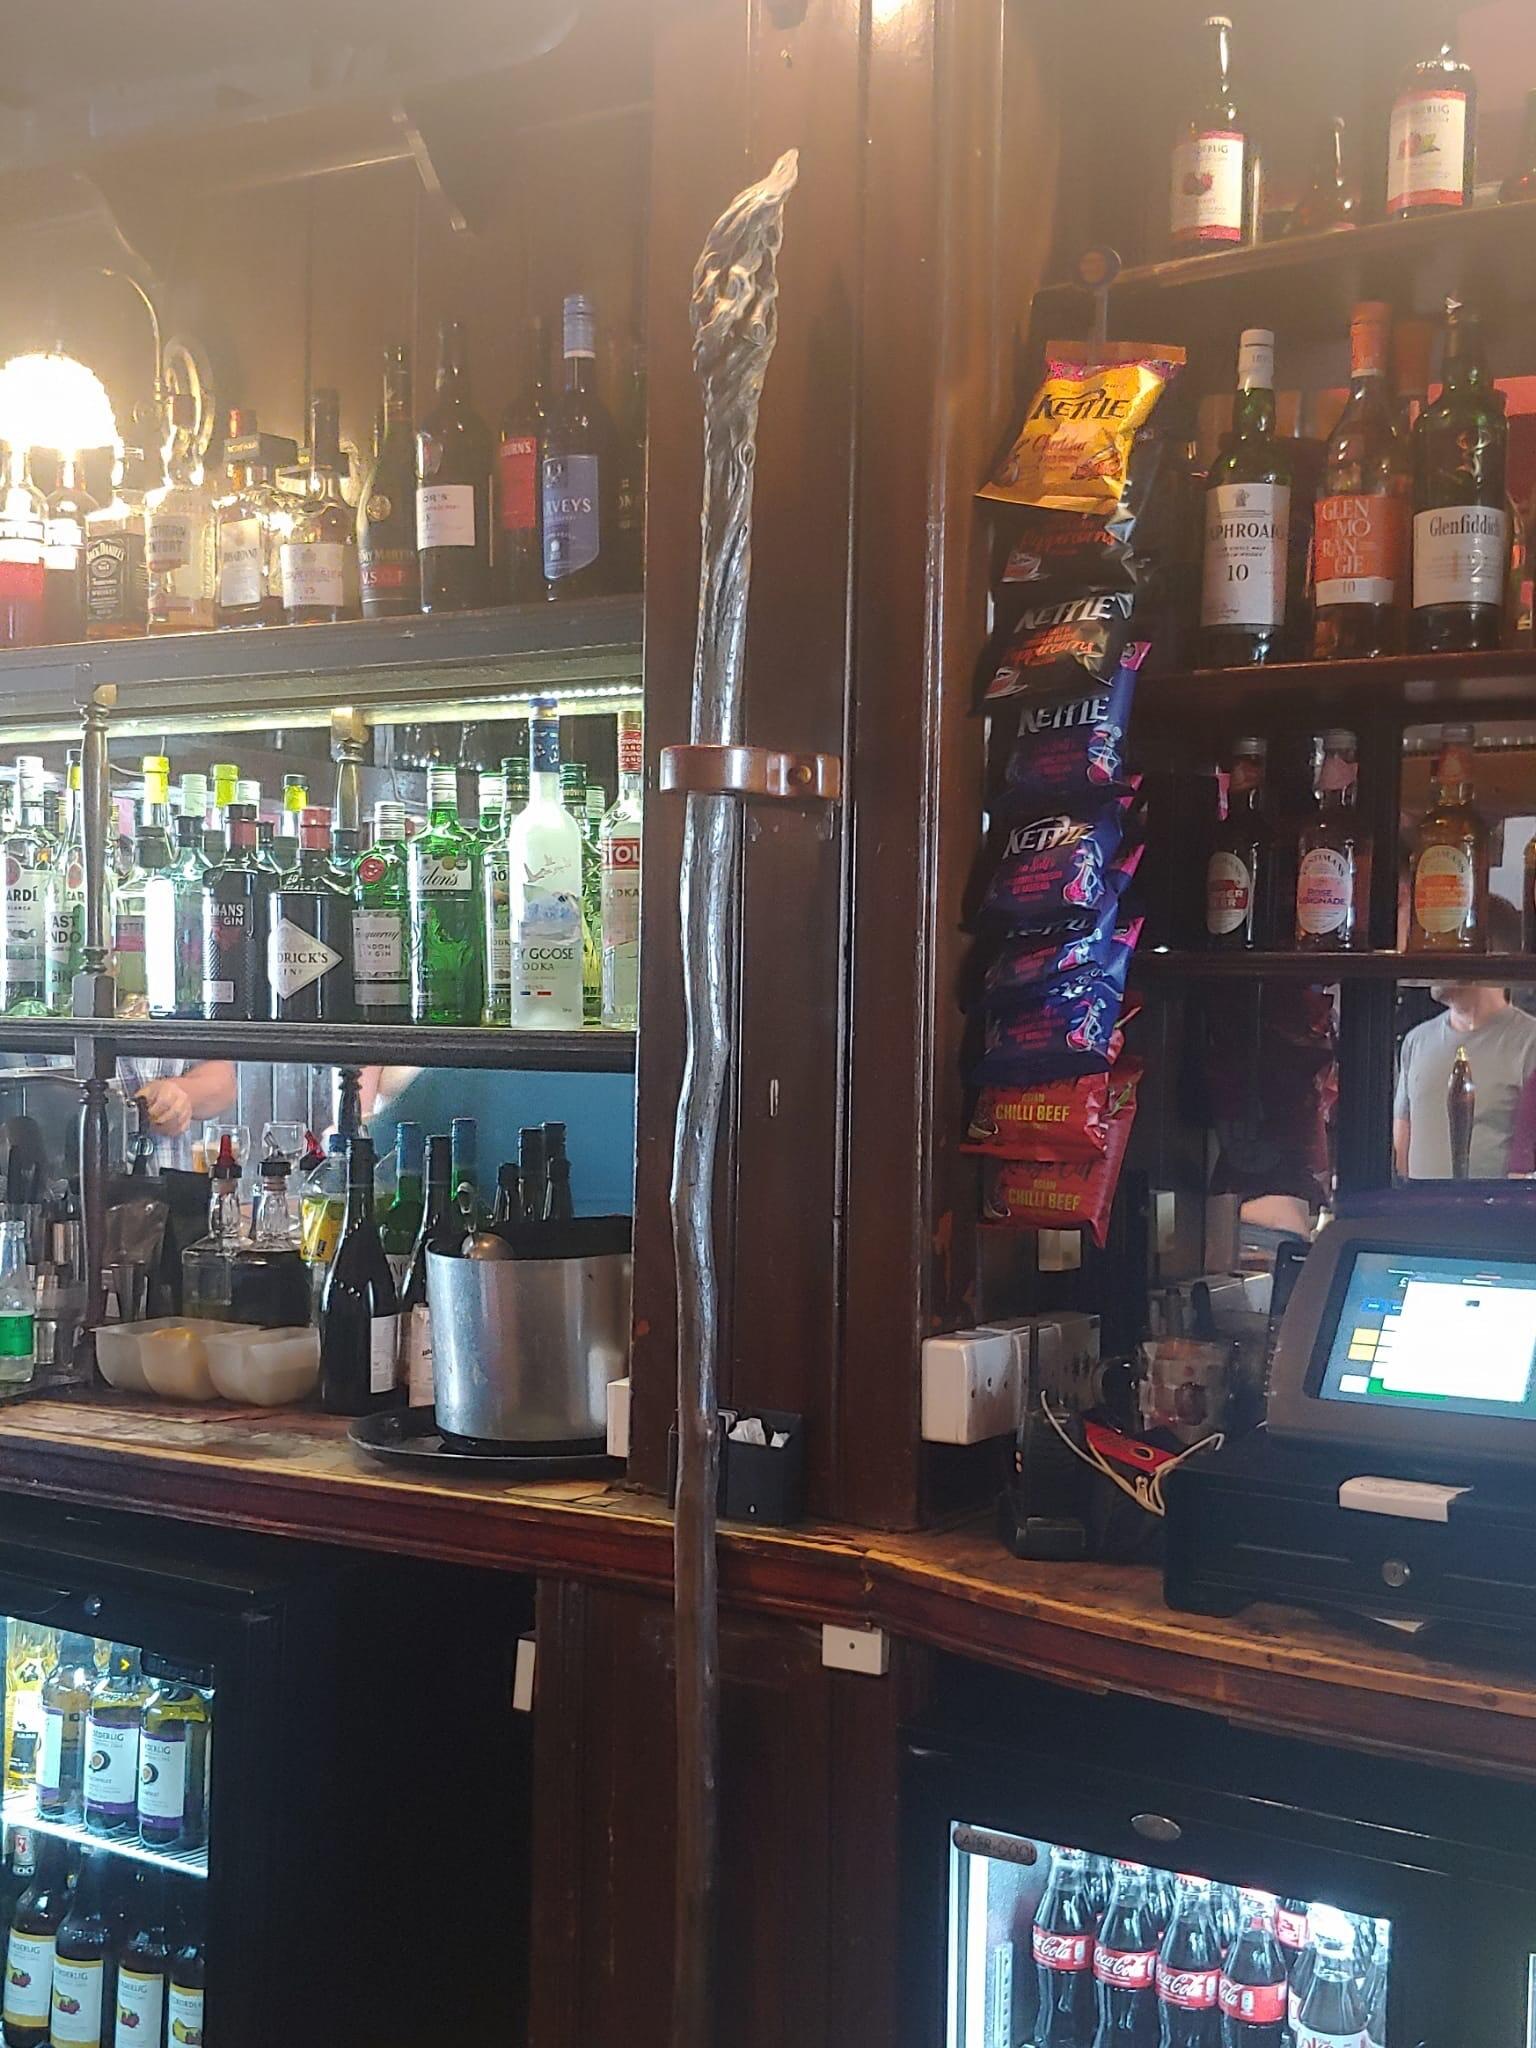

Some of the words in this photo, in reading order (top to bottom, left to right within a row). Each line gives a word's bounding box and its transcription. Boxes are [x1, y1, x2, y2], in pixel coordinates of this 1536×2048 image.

[1031, 387, 1130, 420] KETTLE
[1322, 499, 1370, 521] GLEN
[1336, 519, 1371, 537] MO
[1322, 538, 1358, 557] RAN
[1226, 563, 1250, 582] 10
[1334, 555, 1364, 574] GIE
[1013, 596, 1116, 634] KETTLE
[1017, 696, 1110, 738] KETTLE
[1307, 888, 1333, 897] ROSE
[223, 917, 244, 926] GIN
[529, 948, 575, 960] GOOSE
[995, 1104, 1034, 1121] CHILLI
[1036, 1104, 1071, 1122] BEEF
[1008, 1188, 1046, 1206] CHILLI
[1047, 1192, 1081, 1211] BEEF
